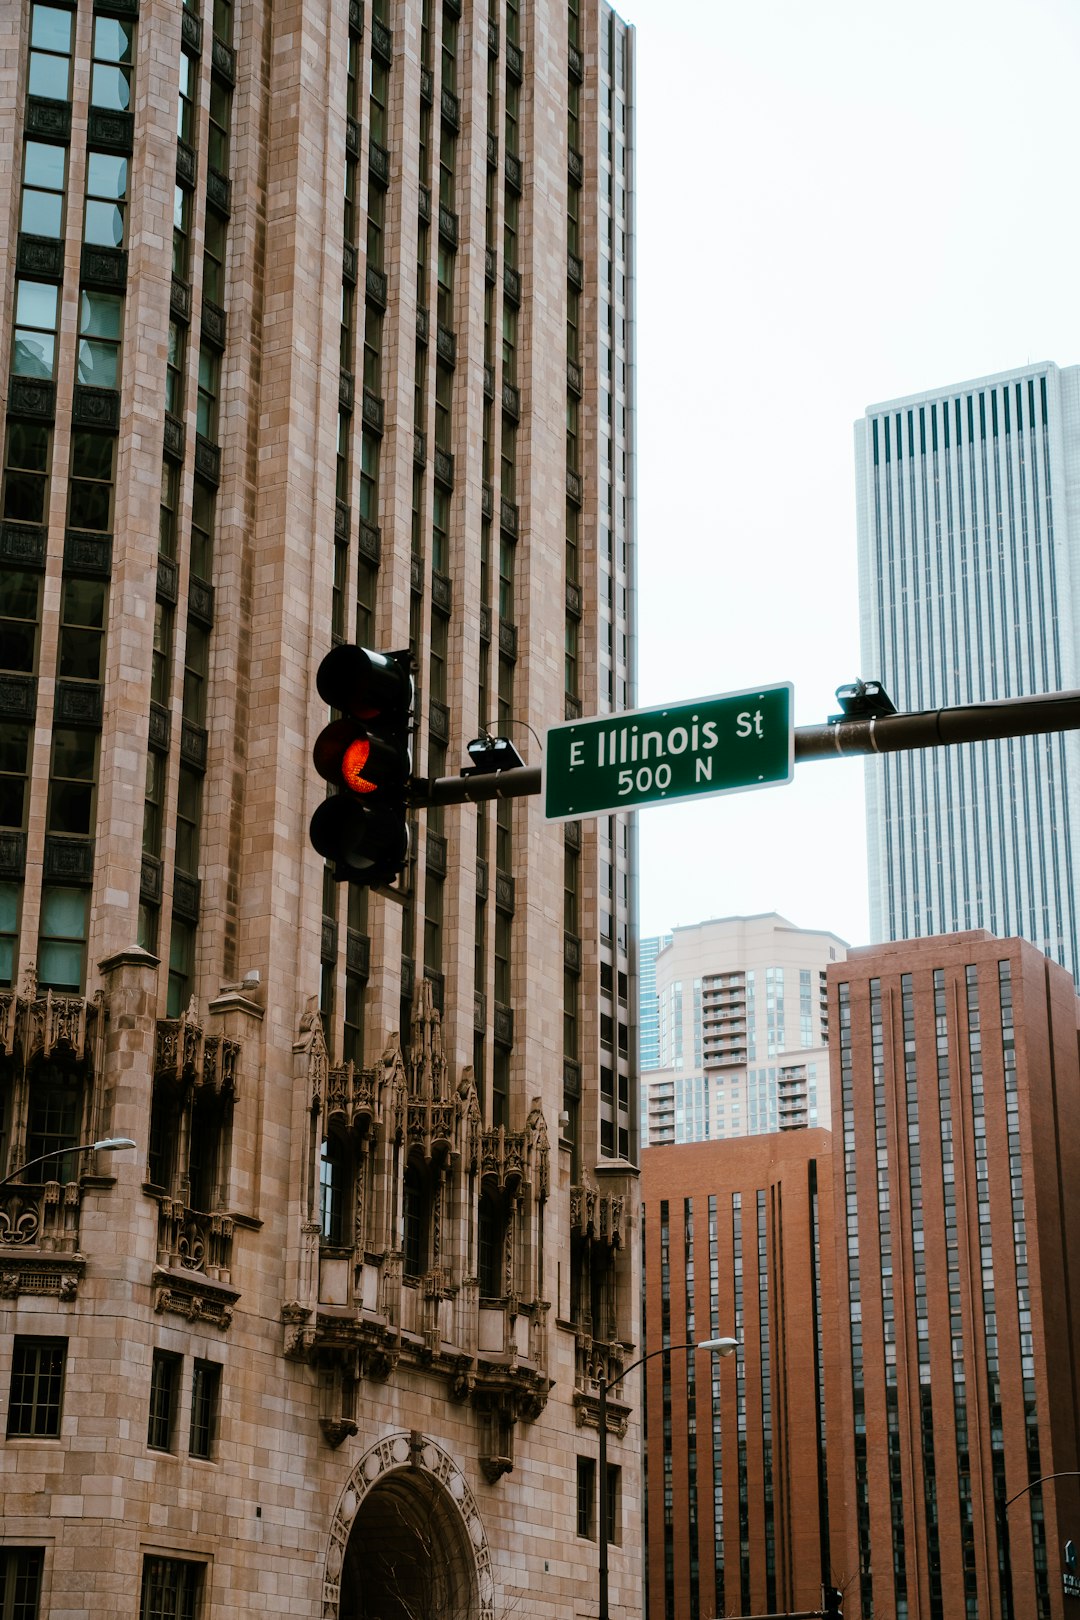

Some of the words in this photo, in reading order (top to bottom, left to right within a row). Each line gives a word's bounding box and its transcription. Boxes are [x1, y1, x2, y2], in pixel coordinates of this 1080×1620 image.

[570, 741, 584, 766] E
[598, 715, 718, 767] Illinois
[736, 710, 763, 737] St
[617, 764, 672, 795] 500
[695, 756, 713, 782] N
